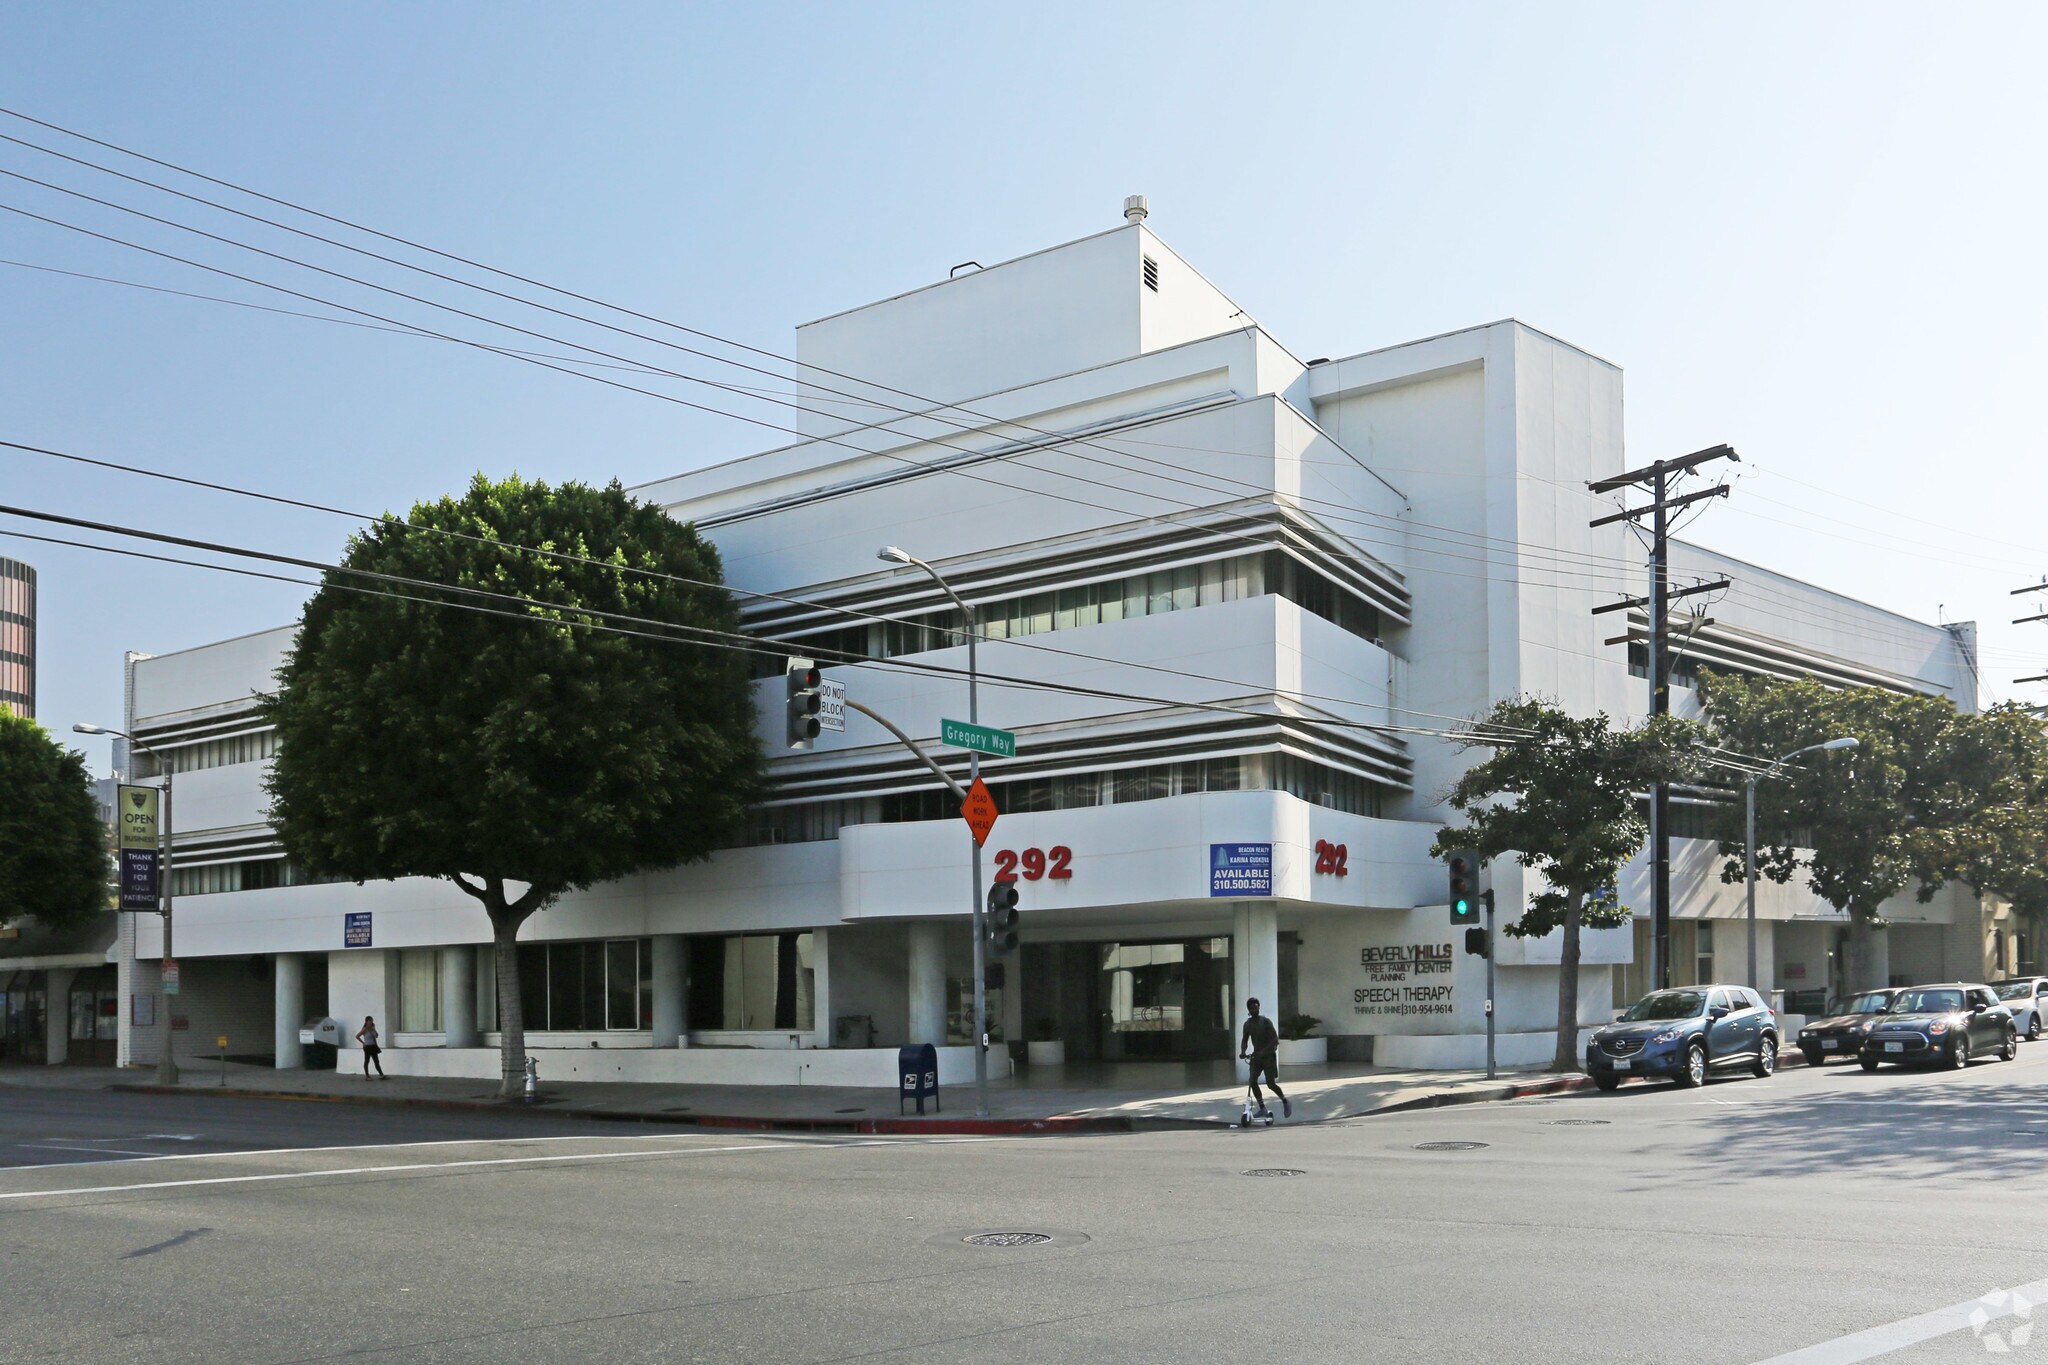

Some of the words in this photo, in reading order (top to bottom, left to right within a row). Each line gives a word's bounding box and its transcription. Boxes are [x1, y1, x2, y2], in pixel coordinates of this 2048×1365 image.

[822, 685, 831, 696] DO
[832, 687, 844, 699] NOT
[821, 701, 844, 715] BLOCK
[947, 726, 987, 749] Gregory
[992, 735, 1010, 754] Way
[972, 794, 987, 803] ROAD
[125, 813, 154, 824] OPEN
[972, 820, 989, 829] AHEAD
[124, 835, 155, 843] BUSINESS
[128, 853, 152, 861] THANK
[1315, 839, 1348, 877] 292
[994, 845, 1072, 883] 292
[1214, 869, 1269, 879] AVAILABLE
[1214, 879, 1269, 890] 310.500.5621
[124, 894, 155, 902] PATIENCE
[1361, 945, 1415, 962] BEVERLY
[1417, 943, 1452, 960] HILLS
[1365, 964, 1385, 973] FREE
[1388, 963, 1411, 973] FAMILY
[1417, 962, 1452, 974] CENTER
[1370, 973, 1406, 982] PLANNING
[1354, 988, 1399, 1003] SPEECH
[1403, 986, 1453, 1001] THERAPY
[1354, 1006, 1376, 1015] THRIVE
[1377, 1006, 1382, 1014] &
[1383, 1005, 1401, 1014] SHINE
[1403, 1004, 1453, 1015] 310-954-9614
